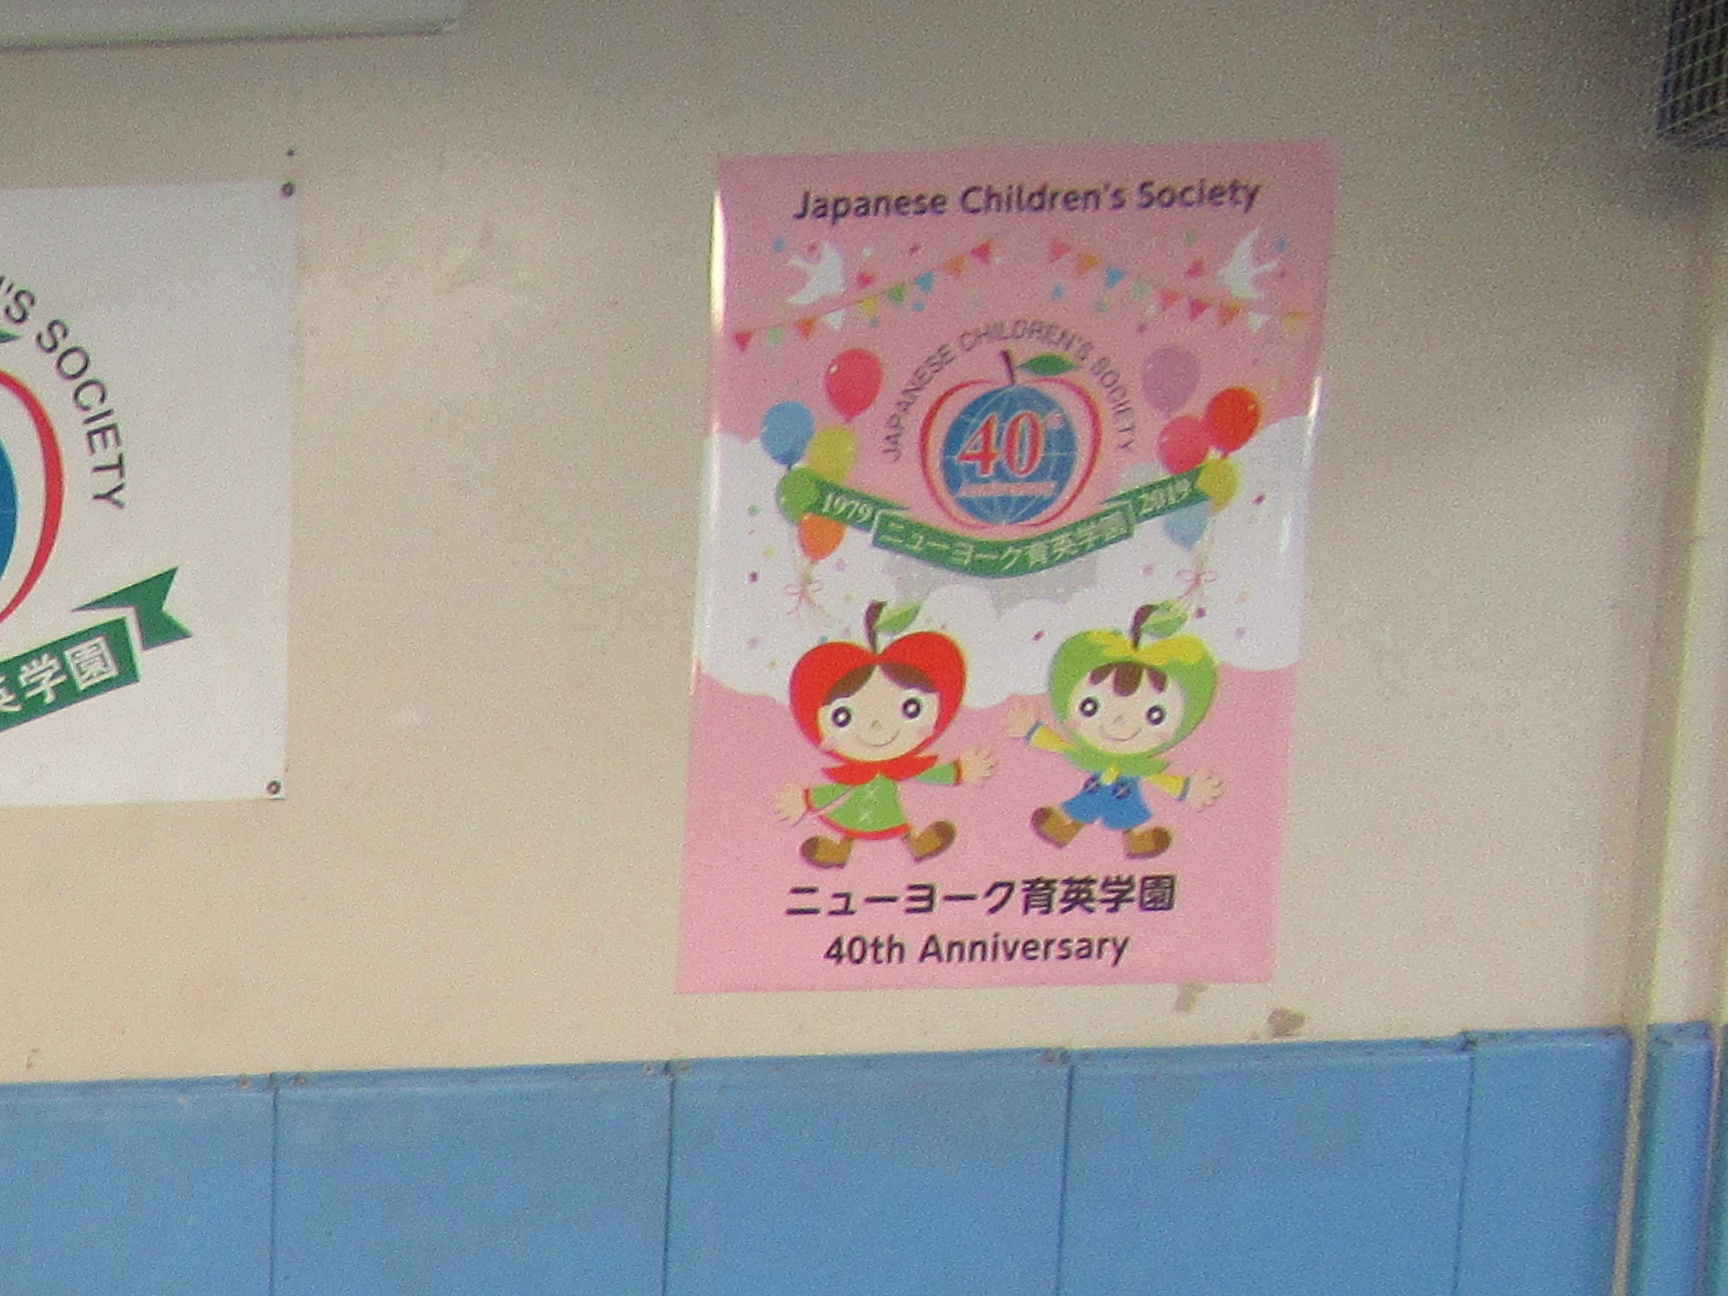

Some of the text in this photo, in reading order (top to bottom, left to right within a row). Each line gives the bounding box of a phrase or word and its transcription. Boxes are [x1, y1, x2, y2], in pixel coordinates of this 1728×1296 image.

[793, 178, 1262, 227] Japanese Children's Society
[35, 319, 126, 511] SOCIETY
[881, 320, 1136, 464] JAPANESE CHILDREN'S SOCIETY
[821, 492, 872, 523] 1979
[785, 874, 1178, 917] ニューヨーク育英学園
[824, 931, 1131, 967] 40th Anniversary
